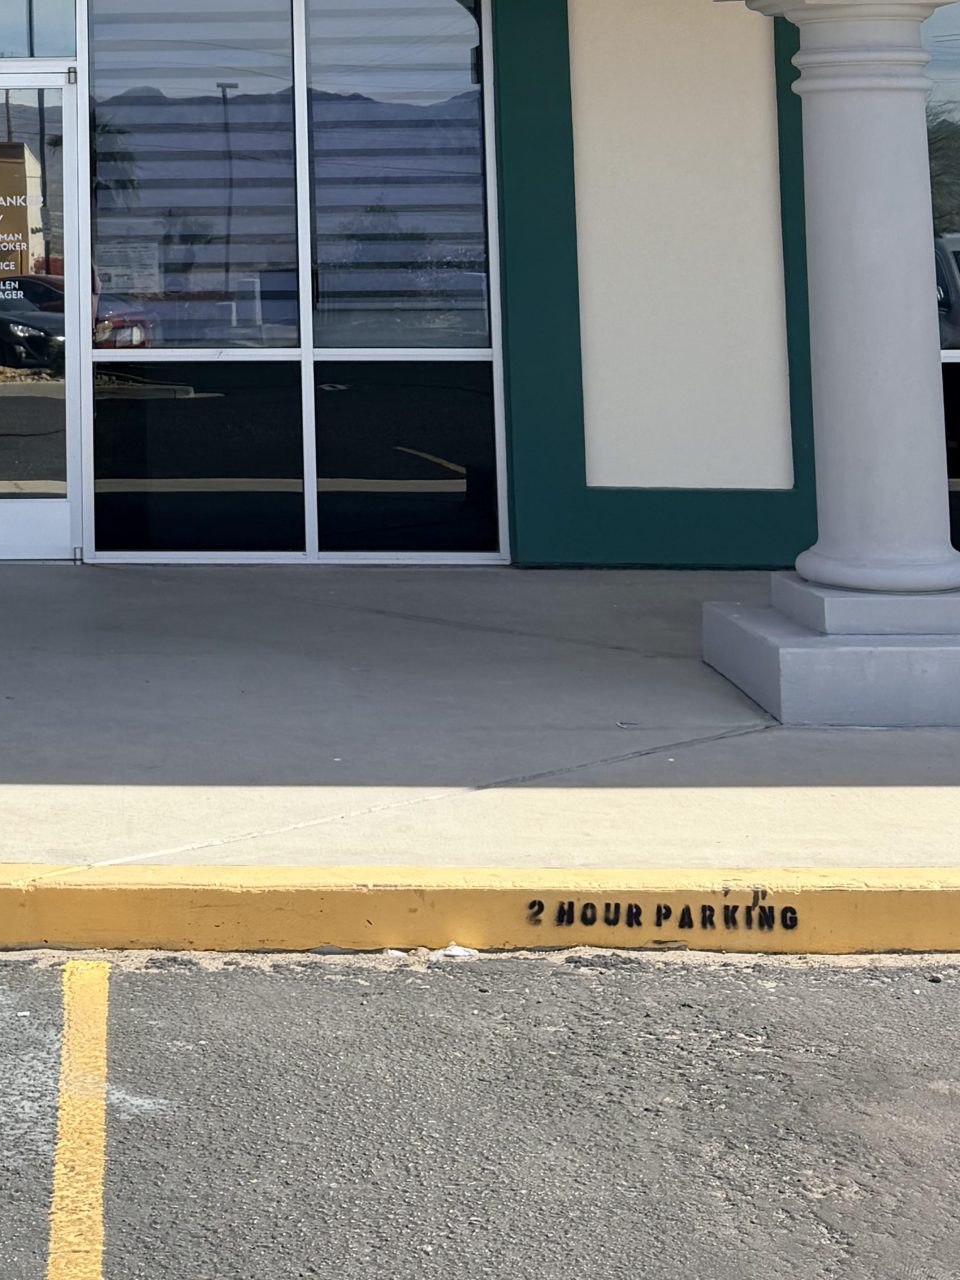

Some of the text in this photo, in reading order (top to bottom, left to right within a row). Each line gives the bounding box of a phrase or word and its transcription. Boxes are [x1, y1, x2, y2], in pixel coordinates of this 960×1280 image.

[527, 899, 799, 931] 2 HOUR PARKING
